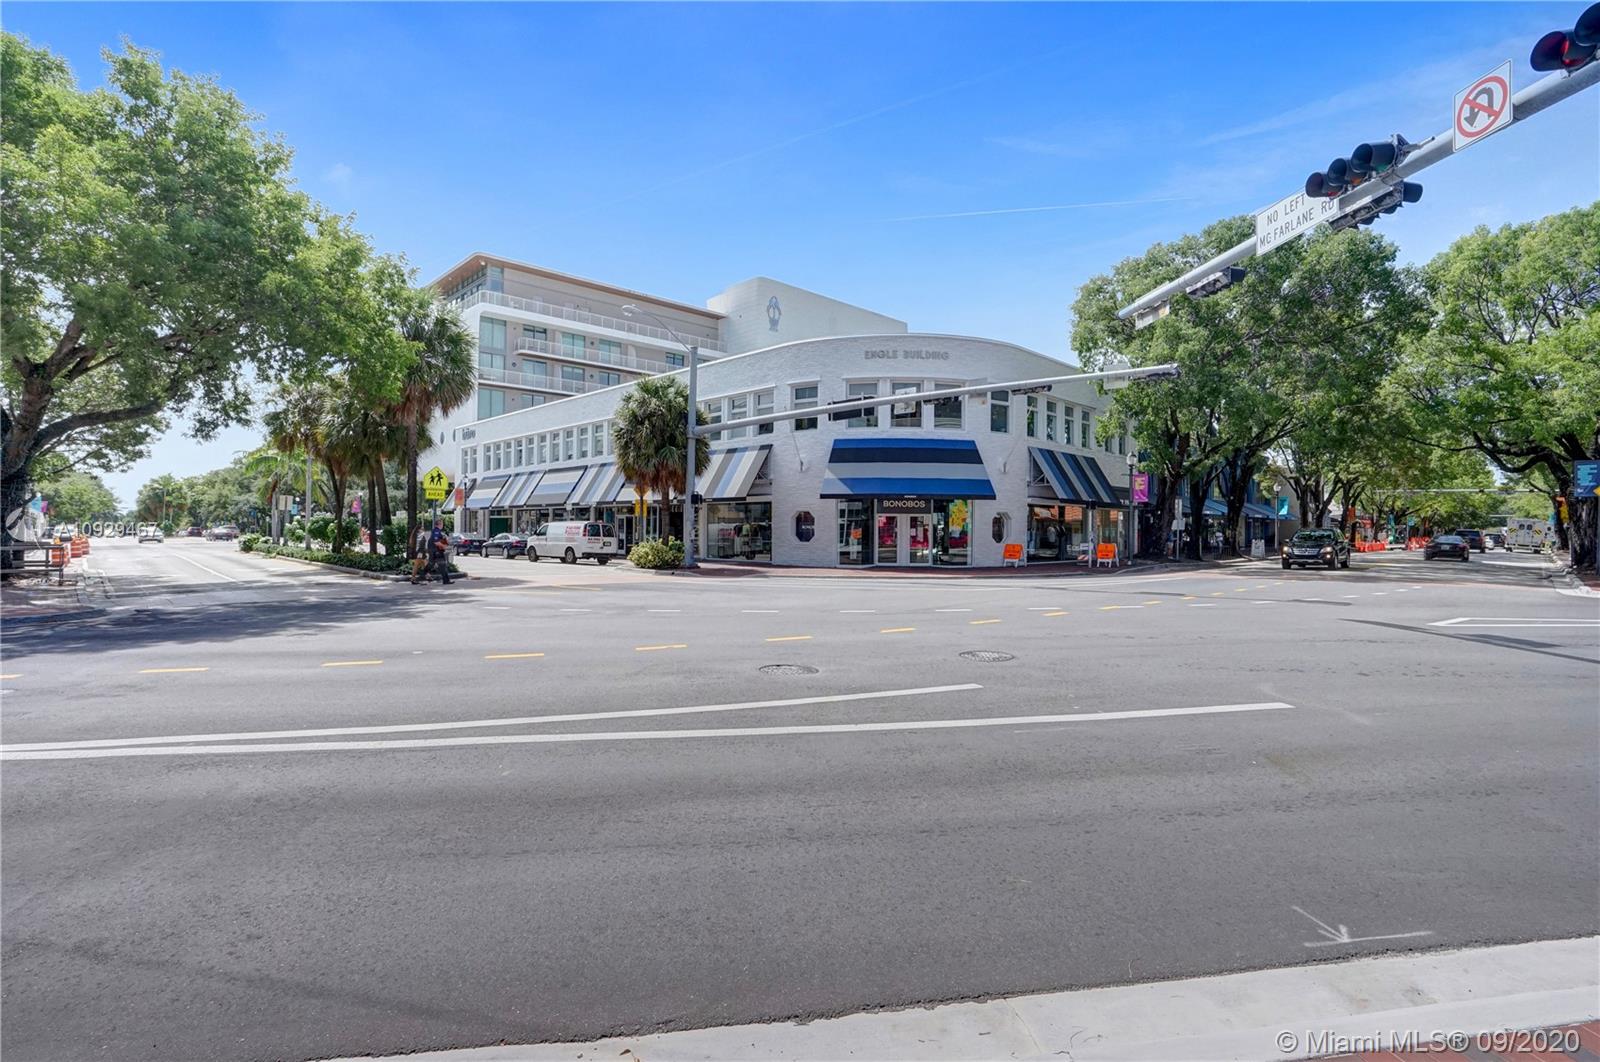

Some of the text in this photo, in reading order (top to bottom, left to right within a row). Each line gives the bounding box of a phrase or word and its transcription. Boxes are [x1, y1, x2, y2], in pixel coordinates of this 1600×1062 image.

[1266, 192, 1306, 227] NO LEFT
[1320, 199, 1335, 215] RD
[864, 349, 951, 360] ENGLE BUILDING
[883, 500, 926, 508] BONOBOS
